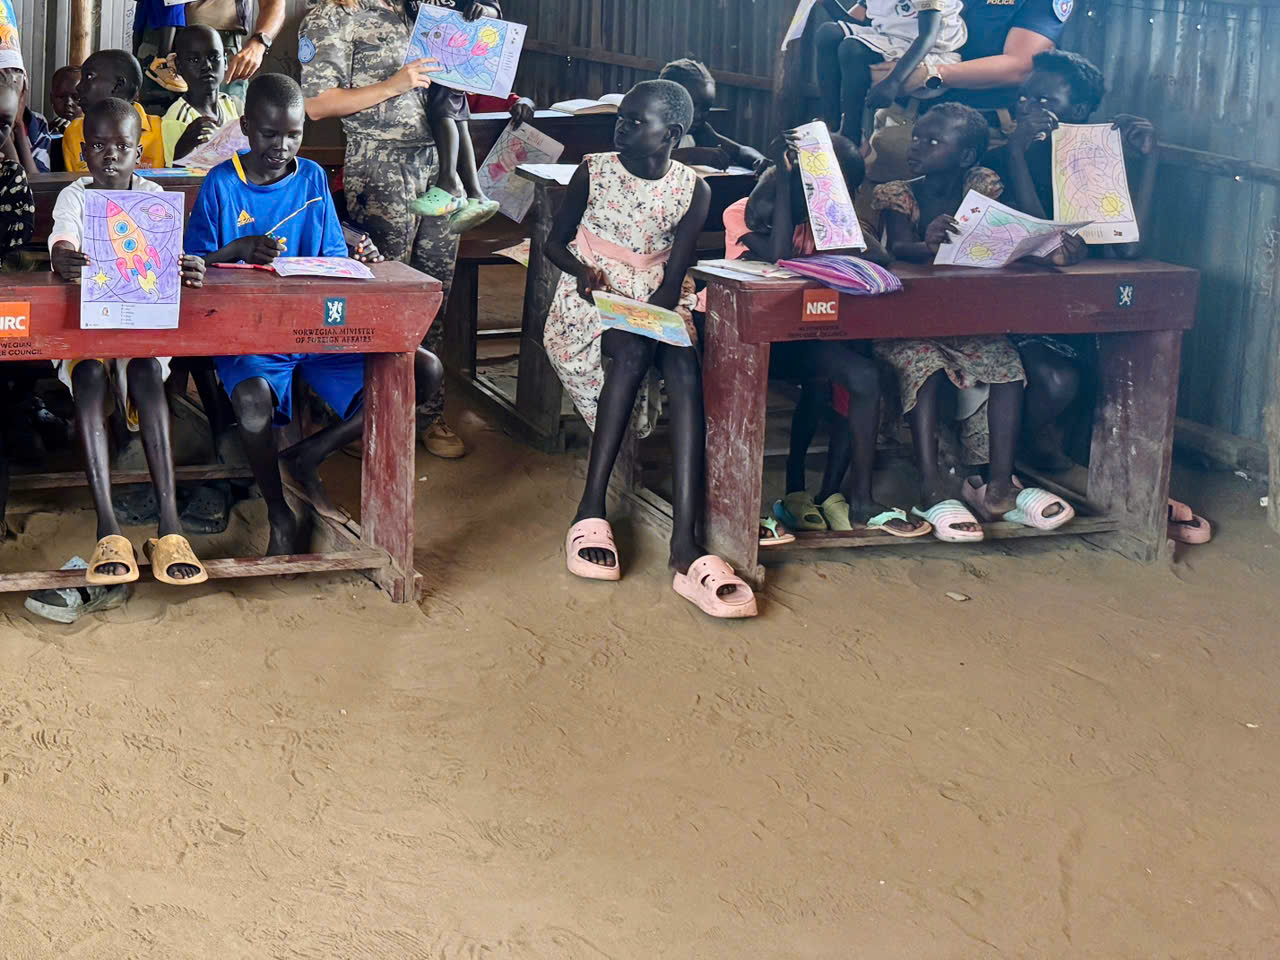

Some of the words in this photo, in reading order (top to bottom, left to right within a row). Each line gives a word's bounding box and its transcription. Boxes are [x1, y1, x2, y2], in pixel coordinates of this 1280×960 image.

[806, 301, 836, 315] NRC
[293, 328, 338, 336] NORWEGIAN
[340, 327, 376, 335] MINISTRY
[341, 335, 372, 343] AFFAIRS
[8, 348, 43, 357] COUNCIL
